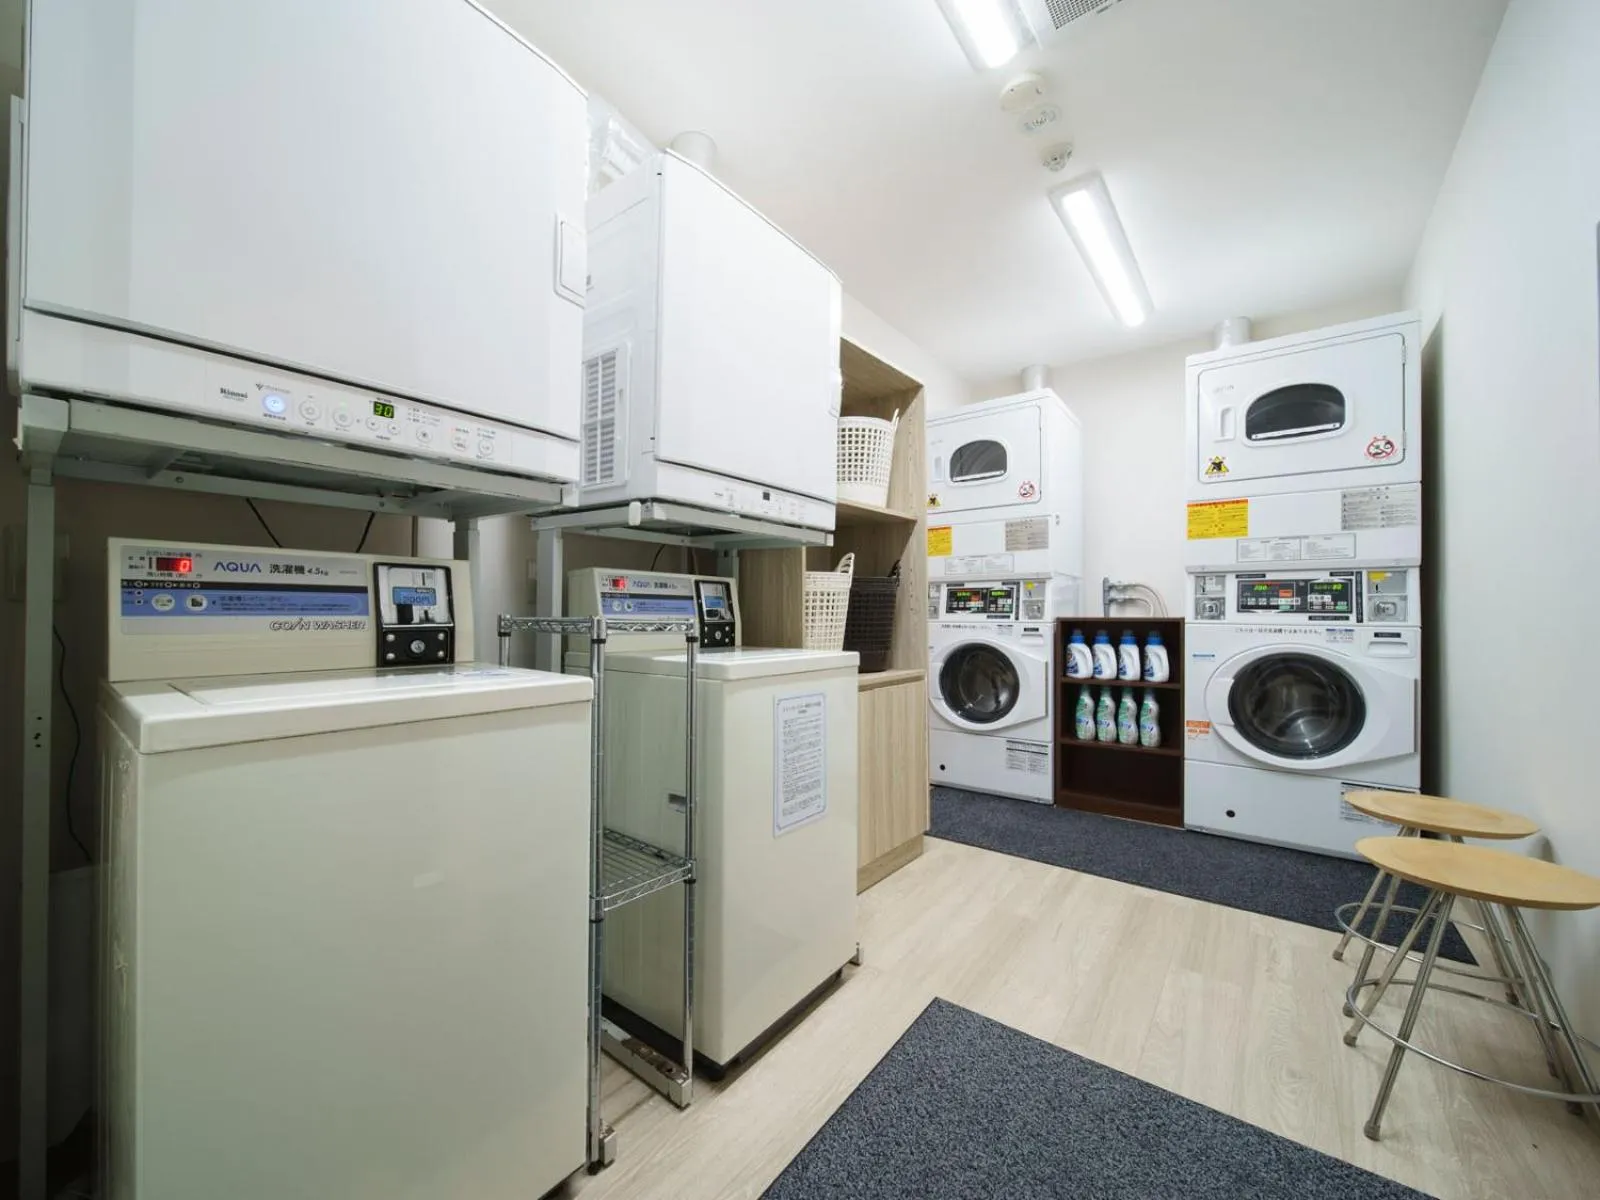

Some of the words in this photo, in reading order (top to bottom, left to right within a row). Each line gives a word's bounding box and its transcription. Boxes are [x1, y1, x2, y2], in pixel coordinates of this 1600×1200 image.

[374, 402, 393, 418] 30
[179, 559, 190, 574] 0
[213, 561, 262, 573] AQUA
[269, 563, 305, 575] 洗濯機
